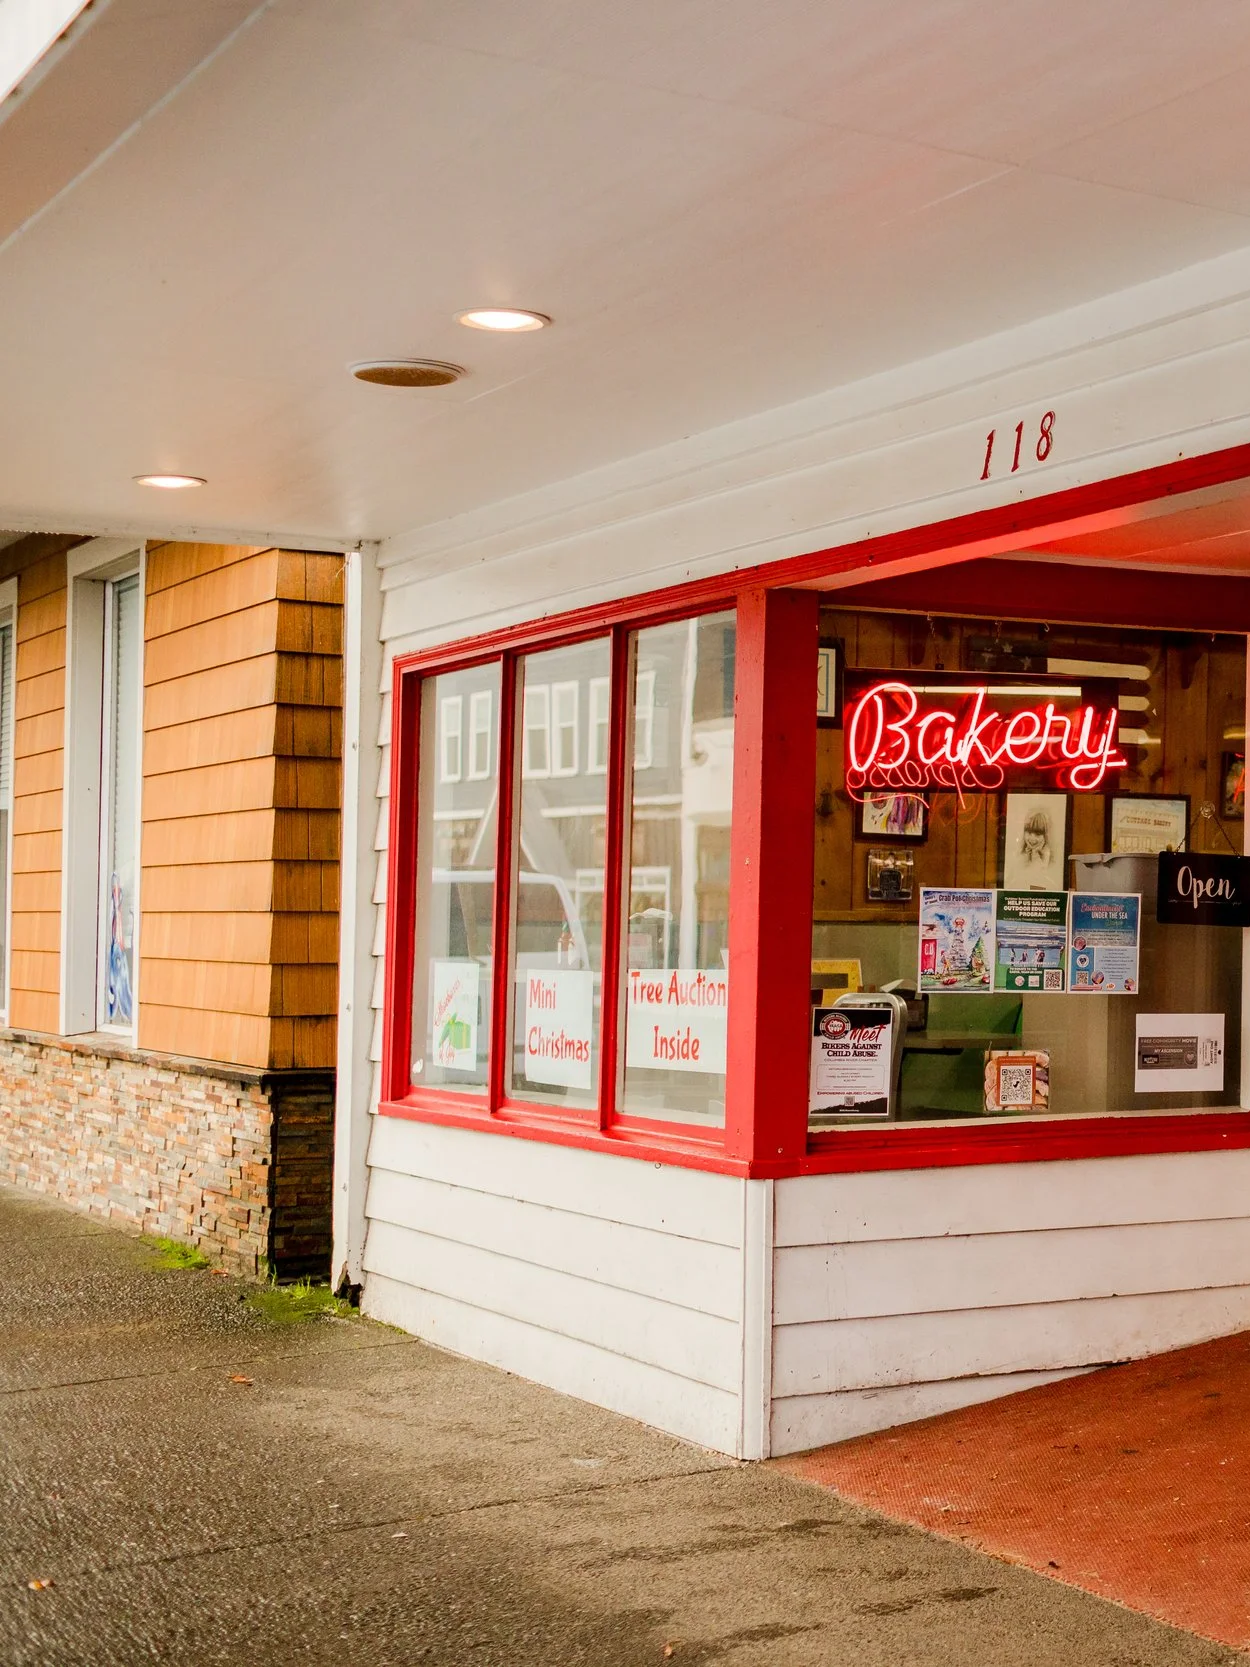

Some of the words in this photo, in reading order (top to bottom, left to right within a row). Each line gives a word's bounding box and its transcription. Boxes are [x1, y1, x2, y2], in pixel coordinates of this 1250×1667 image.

[980, 410, 1056, 481] 118
[847, 681, 1128, 790] Bakery
[938, 894, 952, 902] Crab
[1177, 865, 1236, 910] Open
[1119, 912, 1128, 920] SEA
[529, 979, 557, 1010] Mini
[631, 971, 663, 1005] Tree
[667, 970, 727, 1007] Auction
[528, 1025, 589, 1063] Christmas
[653, 1025, 700, 1061] Inside
[821, 1042, 850, 1050] BIKERS
[851, 1042, 882, 1050] AGAINST
[849, 1023, 887, 1044] Meet
